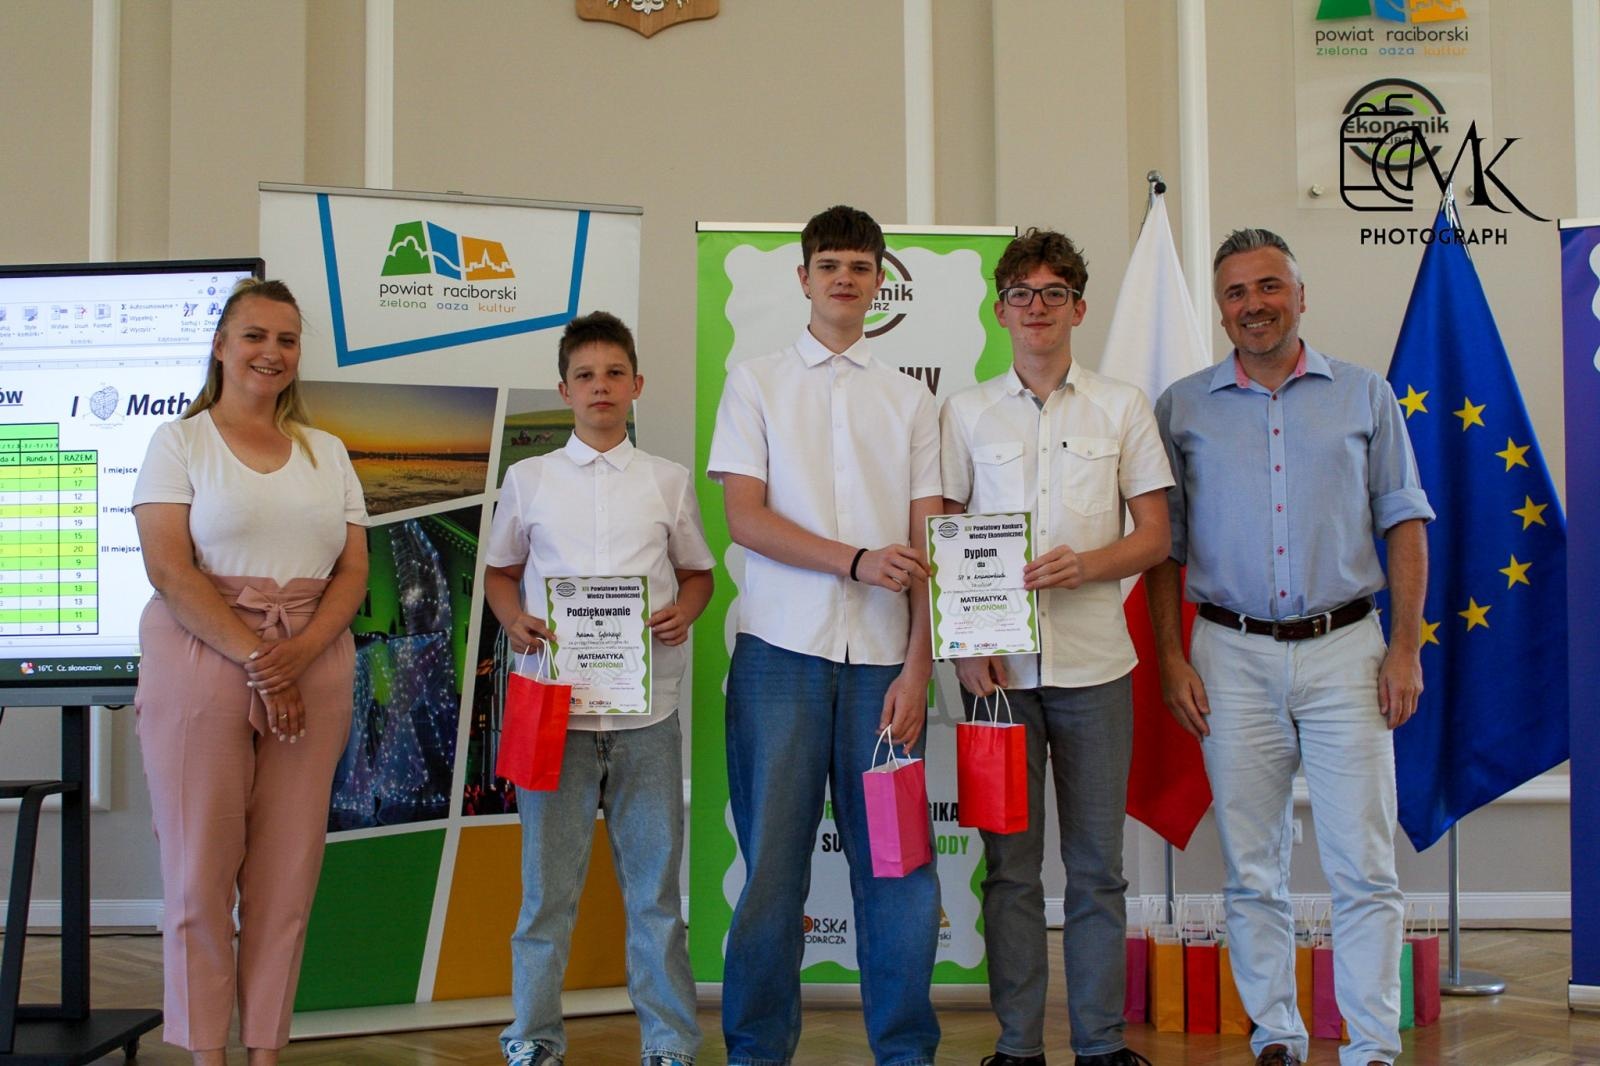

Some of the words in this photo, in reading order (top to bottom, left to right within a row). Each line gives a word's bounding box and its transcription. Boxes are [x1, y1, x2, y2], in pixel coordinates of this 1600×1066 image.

[1315, 26, 1375, 46] powiat
[1386, 26, 1469, 42] raciborski
[1316, 46, 1368, 56] zielona
[1378, 47, 1415, 56] oaza
[1424, 46, 1468, 56] kultur
[379, 281, 433, 298] powiat
[443, 284, 517, 301] raciborski
[379, 299, 427, 309] zielona
[436, 302, 469, 311] oaza
[478, 302, 517, 313] kultur
[71, 395, 79, 417] I
[64, 454, 93, 462] RAZEM
[73, 467, 83, 475] 25
[108, 467, 138, 475] miejsce
[74, 532, 82, 540] 15
[73, 545, 83, 553] 20
[111, 545, 141, 554] miejsce
[964, 547, 998, 560] Dyplom
[960, 594, 1008, 603] MATEMATYKA
[566, 606, 631, 620] Podziękowanie
[76, 624, 82, 632] 5
